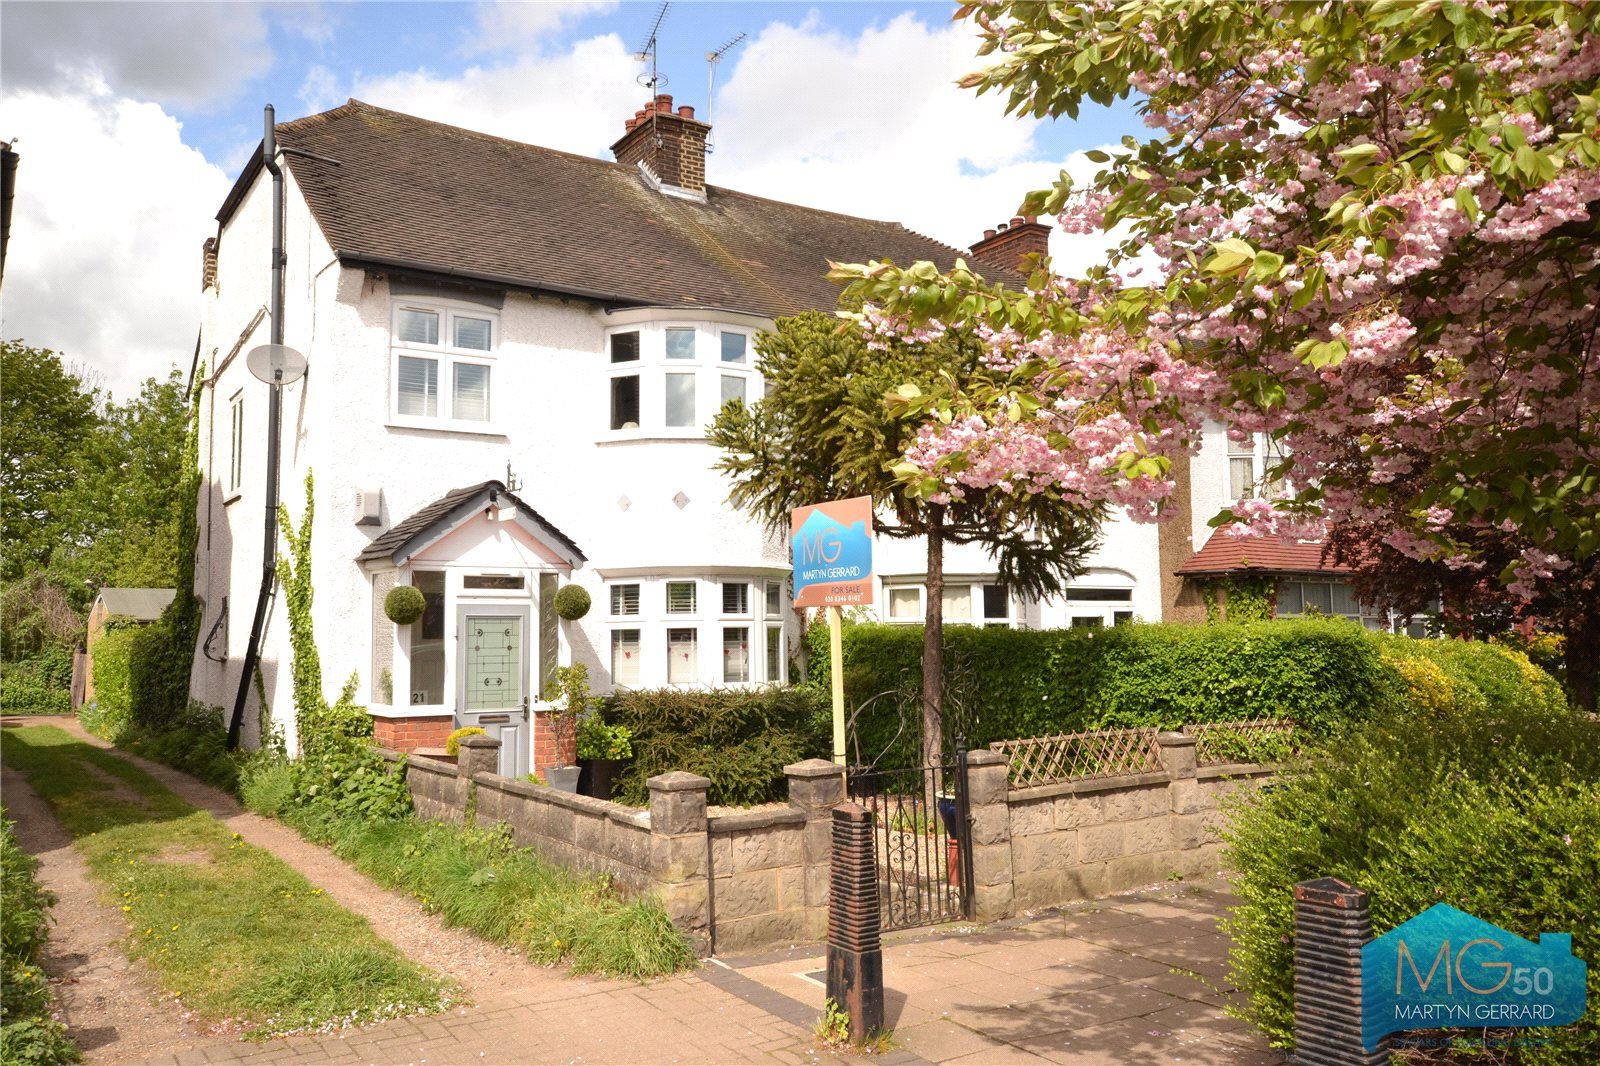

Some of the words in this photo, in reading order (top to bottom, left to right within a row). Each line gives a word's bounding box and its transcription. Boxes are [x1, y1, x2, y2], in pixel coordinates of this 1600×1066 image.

[802, 527, 842, 566] MG
[802, 569, 827, 580] MARTYN
[827, 566, 861, 578] GERRARD
[831, 586, 844, 594] FOR
[845, 585, 861, 594] SALE
[412, 692, 424, 704] 21
